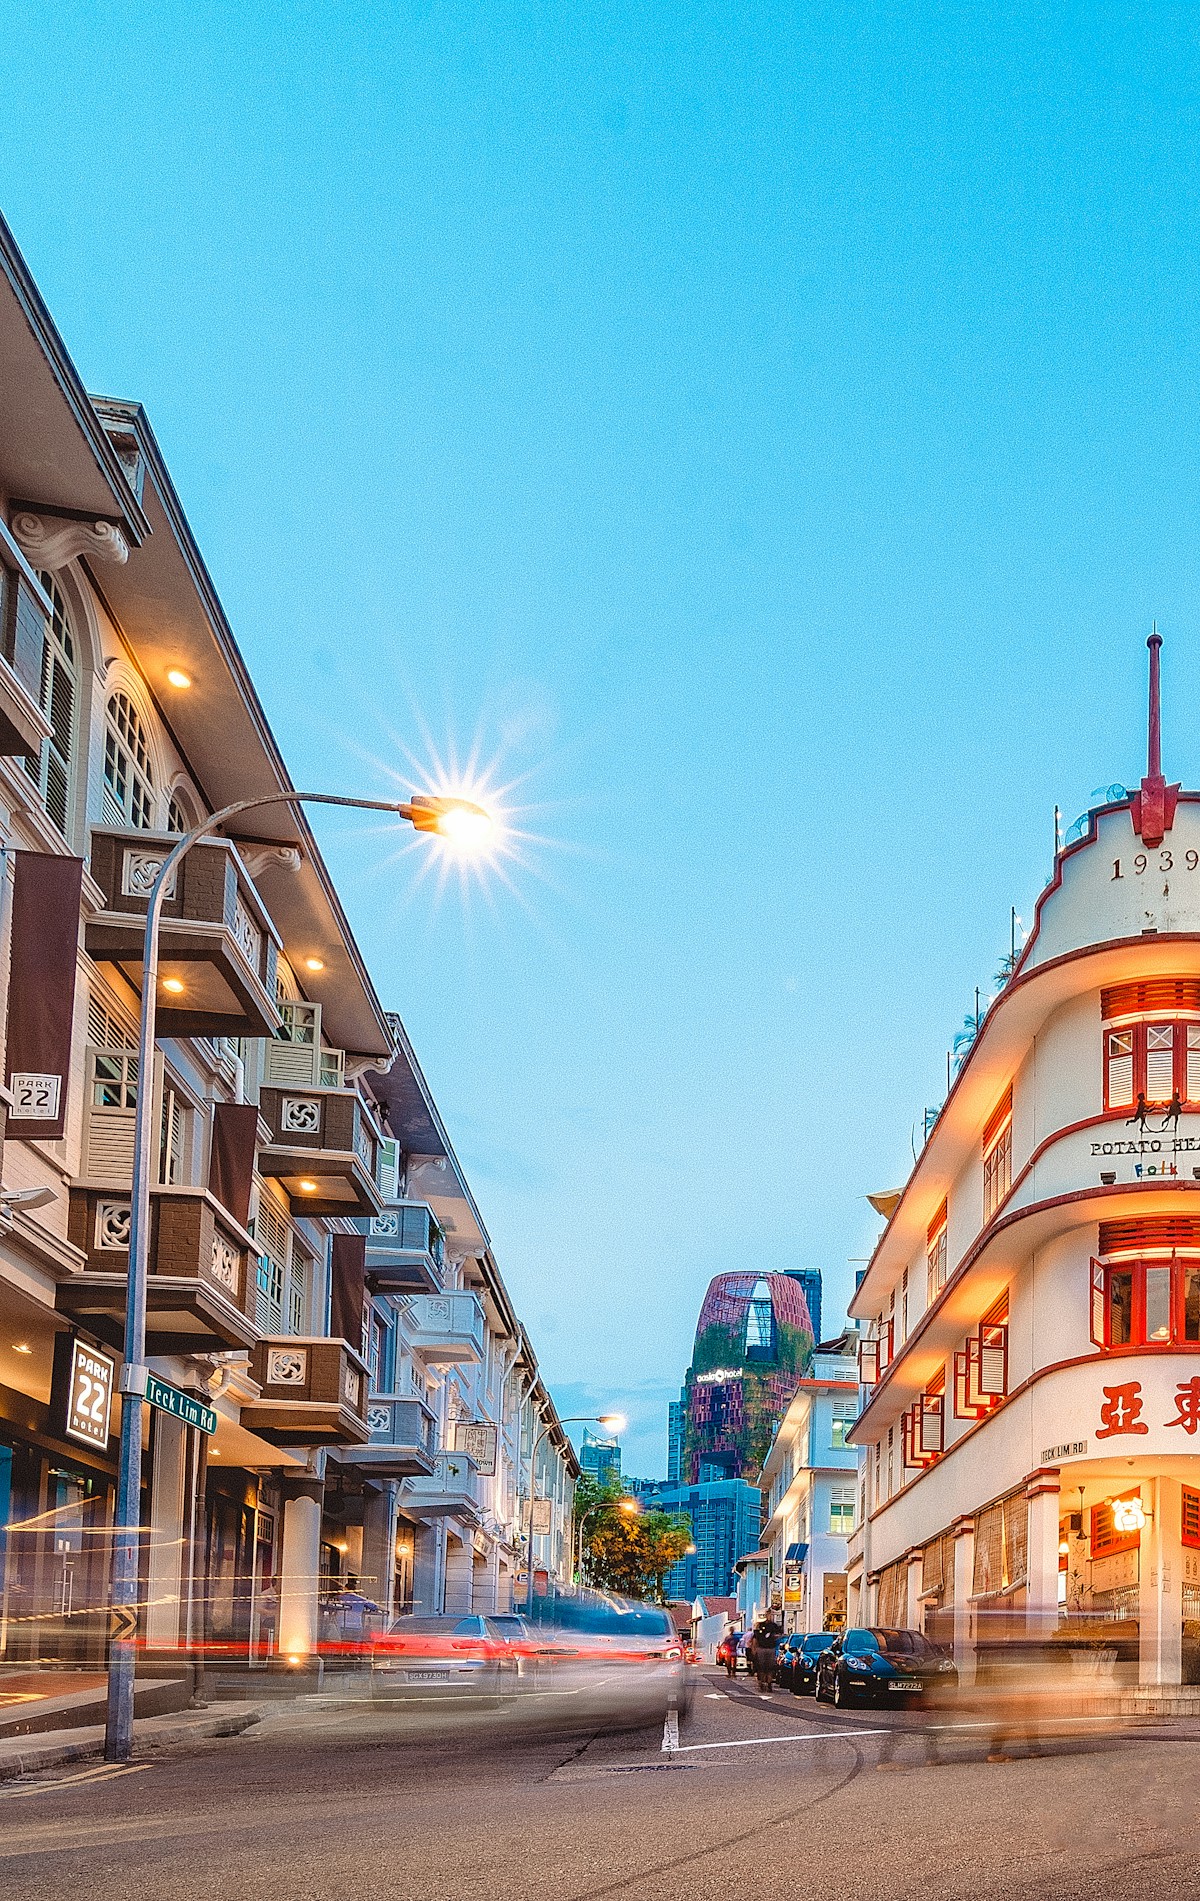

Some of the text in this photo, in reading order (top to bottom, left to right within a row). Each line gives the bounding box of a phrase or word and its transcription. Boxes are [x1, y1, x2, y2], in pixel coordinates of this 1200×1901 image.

[1110, 849, 1199, 882] 1939
[18, 1080, 52, 1089] PARK
[20, 1088, 49, 1107] 22
[1090, 1140, 1162, 1156] POTATO
[1135, 1160, 1178, 1178] Folk
[78, 1352, 109, 1383] PARK
[725, 1368, 742, 1378] hotel
[76, 1375, 106, 1423] 22
[150, 1380, 214, 1431] Teck Lim Rd
[72, 1415, 104, 1438] hotel
[1042, 1442, 1083, 1462] TECK LIM RD
